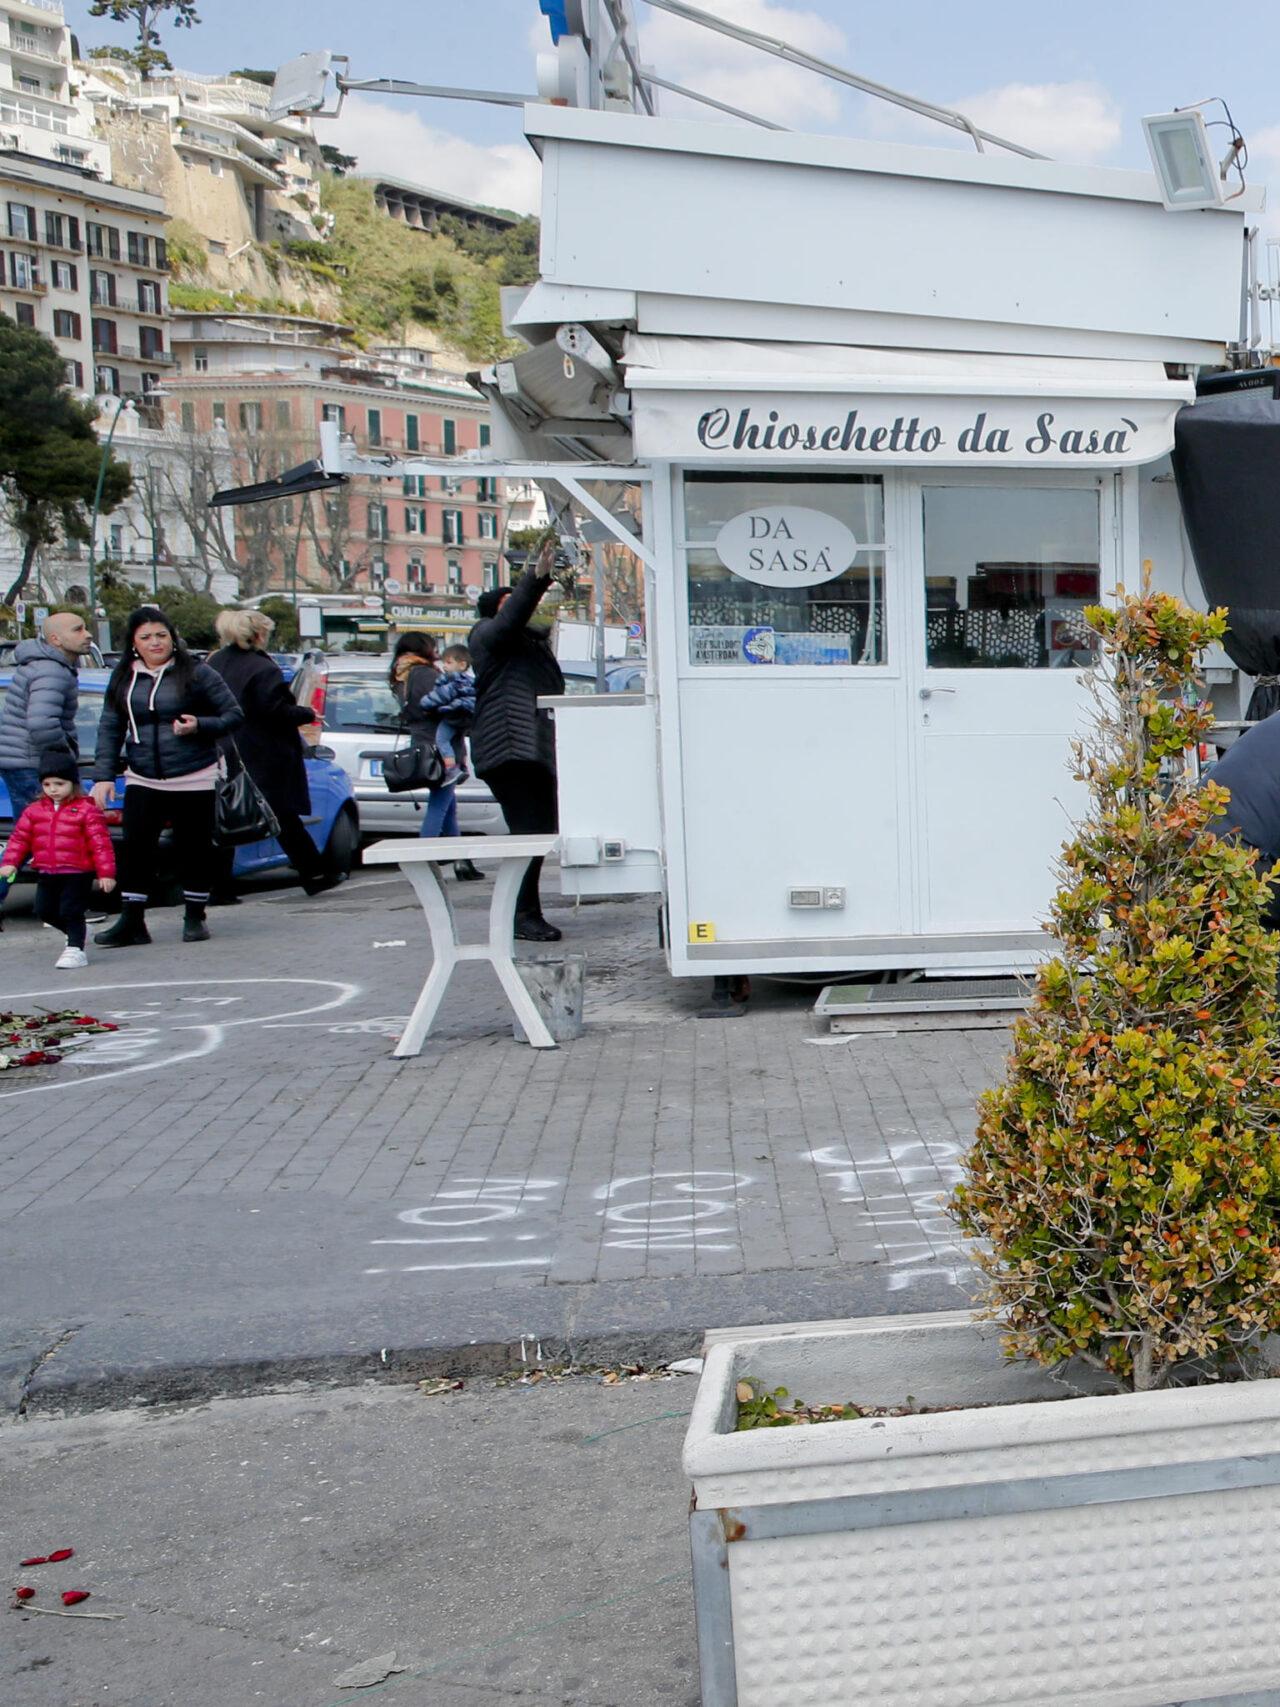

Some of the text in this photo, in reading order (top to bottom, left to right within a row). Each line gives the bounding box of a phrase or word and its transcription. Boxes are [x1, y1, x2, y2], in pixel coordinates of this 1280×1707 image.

[697, 407, 946, 453] Chioschetto
[957, 411, 1012, 453] da
[749, 515, 794, 540] DA
[696, 924, 708, 938] E
[594, 1170, 754, 1251] CON
